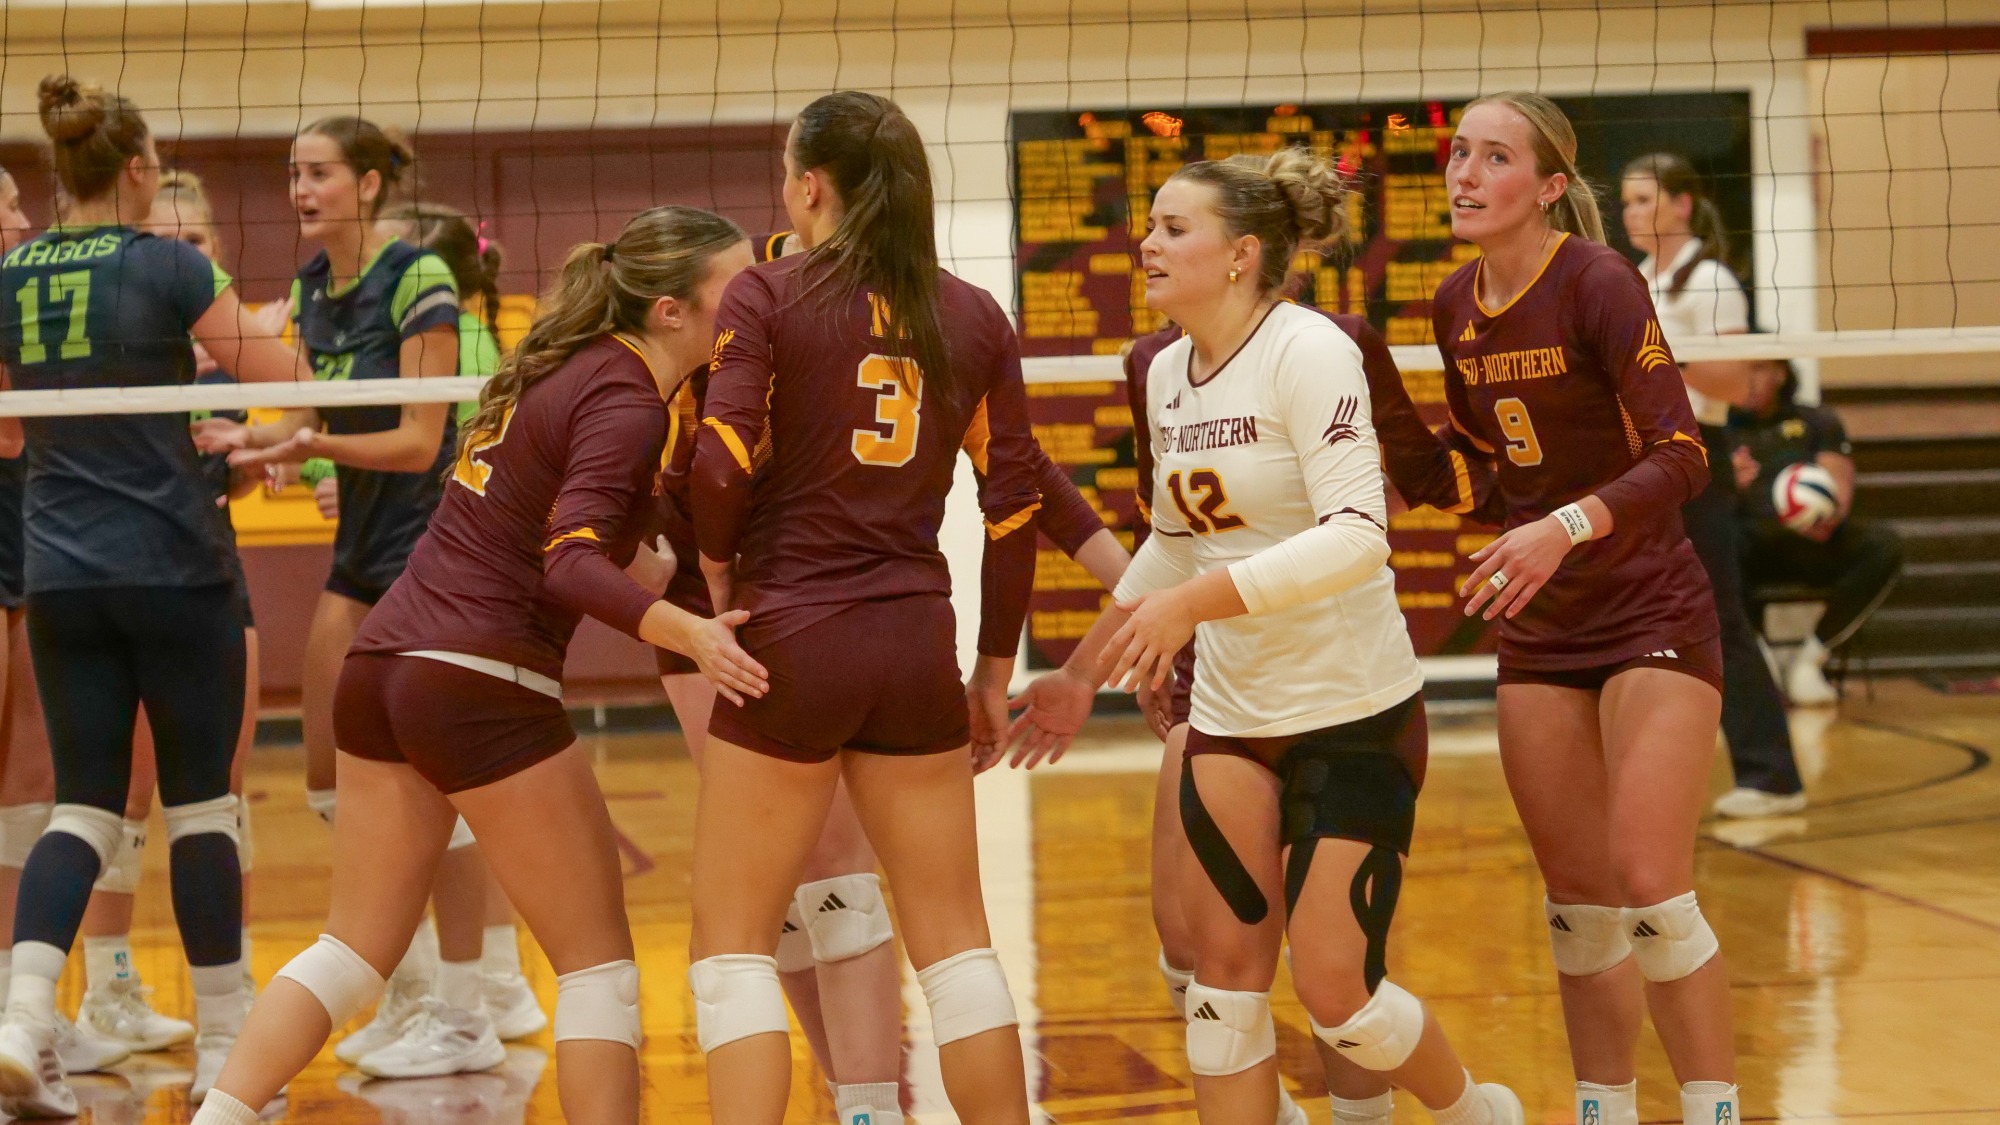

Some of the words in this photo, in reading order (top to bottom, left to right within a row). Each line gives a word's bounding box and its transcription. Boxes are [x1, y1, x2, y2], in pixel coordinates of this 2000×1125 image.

[2, 233, 122, 269] ARGOS
[15, 268, 92, 366] 17
[850, 352, 925, 468] 3
[1493, 396, 1544, 468] 9
[1165, 466, 1249, 538] 12
